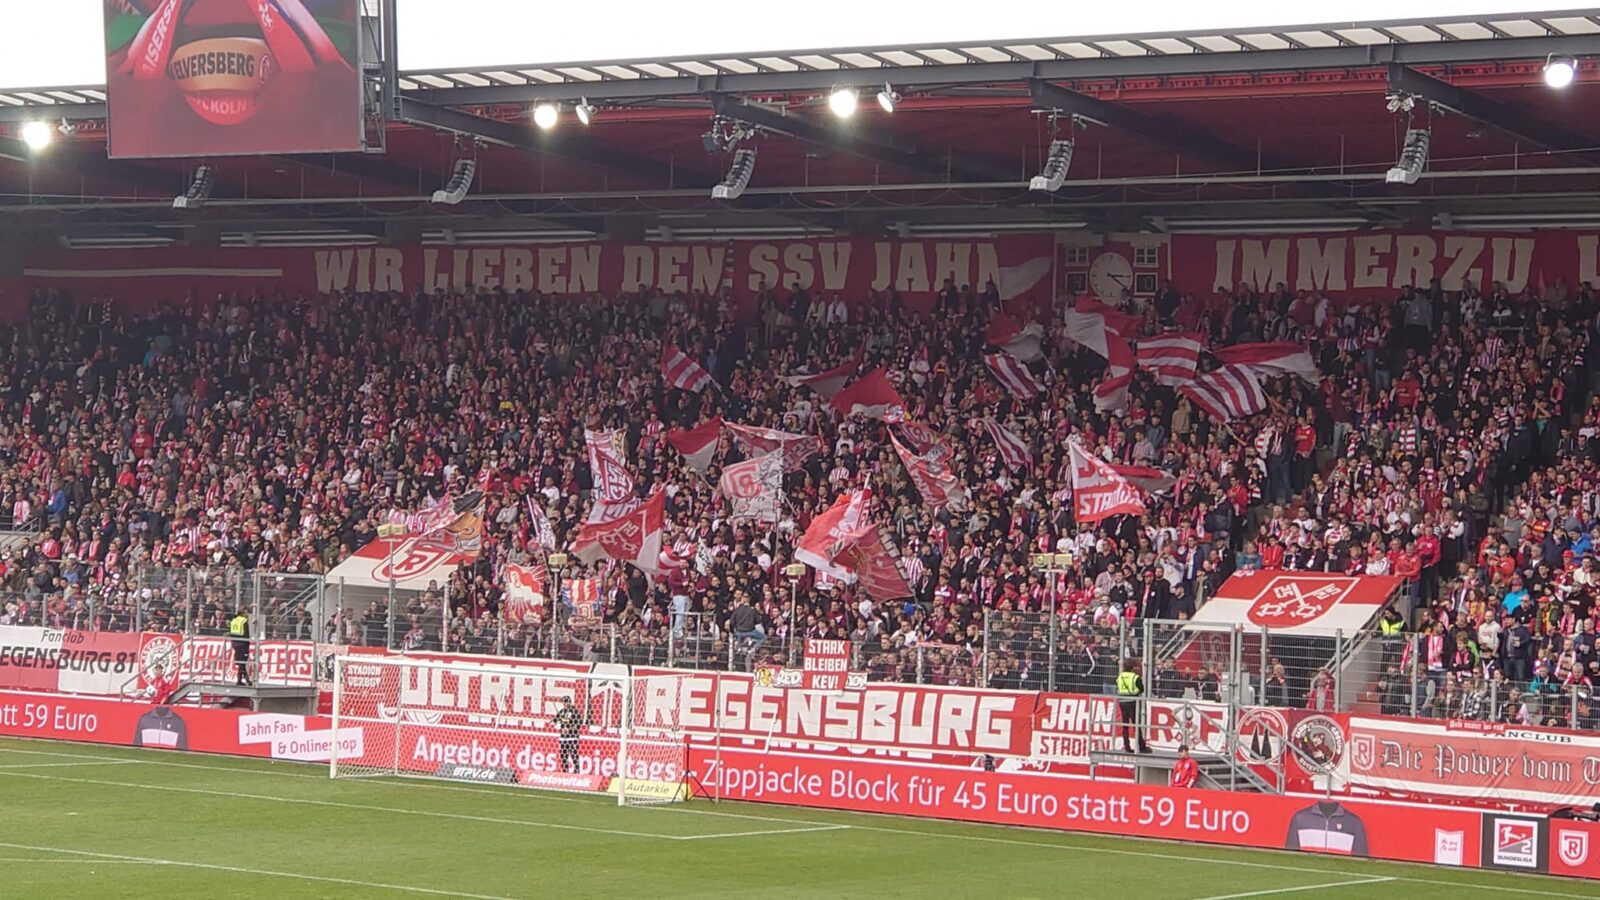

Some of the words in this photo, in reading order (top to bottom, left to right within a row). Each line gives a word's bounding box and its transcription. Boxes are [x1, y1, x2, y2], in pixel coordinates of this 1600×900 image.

[314, 249, 404, 293] WIR
[423, 246, 602, 294] LIEBEN
[621, 246, 727, 294] DEN
[749, 242, 853, 291] SSV
[1212, 234, 1536, 294] IMMERZU
[41, 629, 85, 643] Fanclub
[808, 641, 845, 655] STARK
[113, 651, 137, 674] 81
[804, 657, 848, 672] BLEIBEN
[400, 659, 579, 716] ULTRAS
[811, 674, 839, 690] KEV!
[23, 702, 49, 728] 59
[54, 705, 97, 732] Euro
[645, 674, 1015, 750] REGENSBURG
[1041, 698, 1116, 733] JAHN
[245, 722, 271, 736] Jahn
[274, 721, 298, 734] Fan-
[278, 741, 287, 754] &
[1381, 740, 1424, 770] Die
[1433, 743, 1515, 778] Power
[1522, 753, 1573, 783] vom
[413, 735, 509, 769] Angebot
[516, 744, 557, 772] des
[563, 748, 677, 783] pieltags
[702, 759, 822, 797] Zippjacke
[831, 768, 900, 802] Block
[907, 775, 945, 805] für
[952, 781, 988, 811] 45
[997, 784, 1058, 816] Euro
[1067, 793, 1130, 824] statt
[1137, 796, 1175, 826] 59
[1184, 800, 1250, 834] Euro
[625, 782, 670, 795] Autarkie
[1520, 839, 1532, 854] 2
[1497, 854, 1533, 864] BUNDESLIGA
